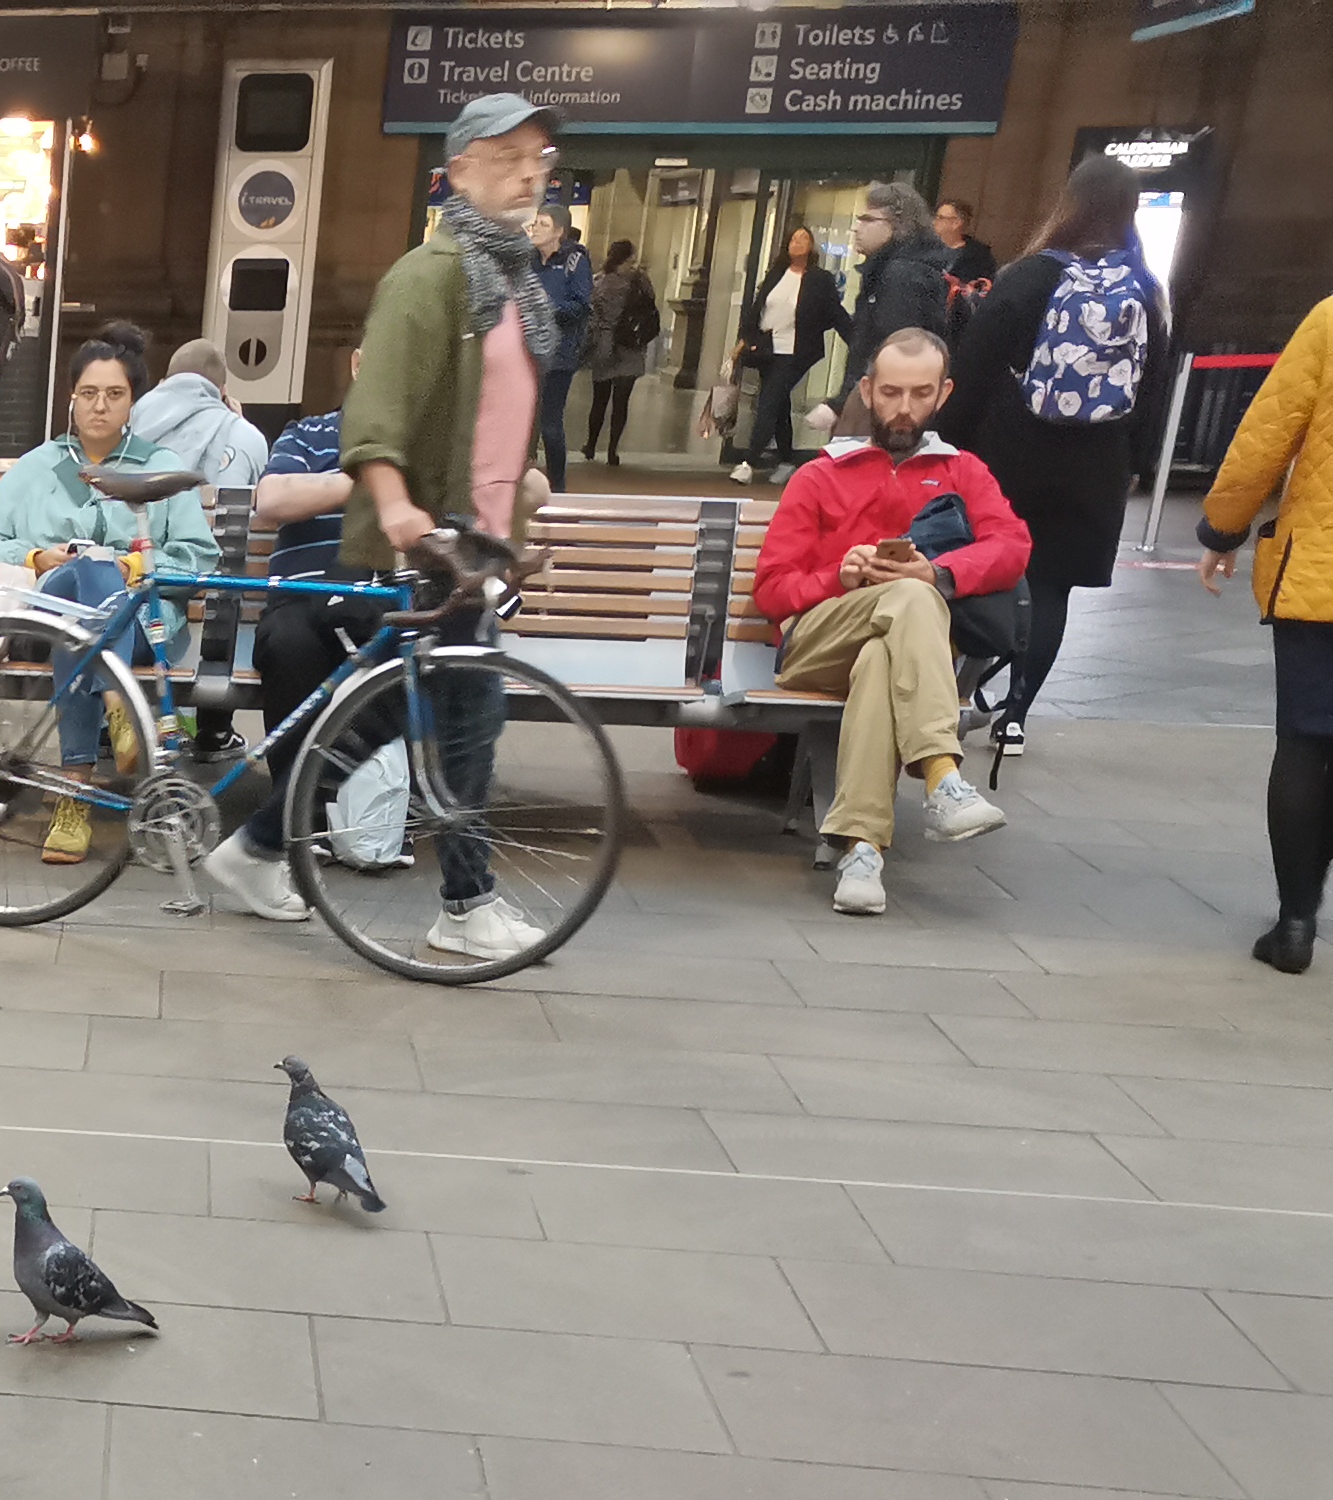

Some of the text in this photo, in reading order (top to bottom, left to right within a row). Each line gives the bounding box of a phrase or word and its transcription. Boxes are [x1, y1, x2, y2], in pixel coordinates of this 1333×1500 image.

[444, 27, 525, 48] Tickets
[795, 24, 876, 46] Toilets
[440, 60, 593, 83] Travel Centre
[789, 58, 881, 84] Seating
[785, 88, 963, 111] Cash machines
